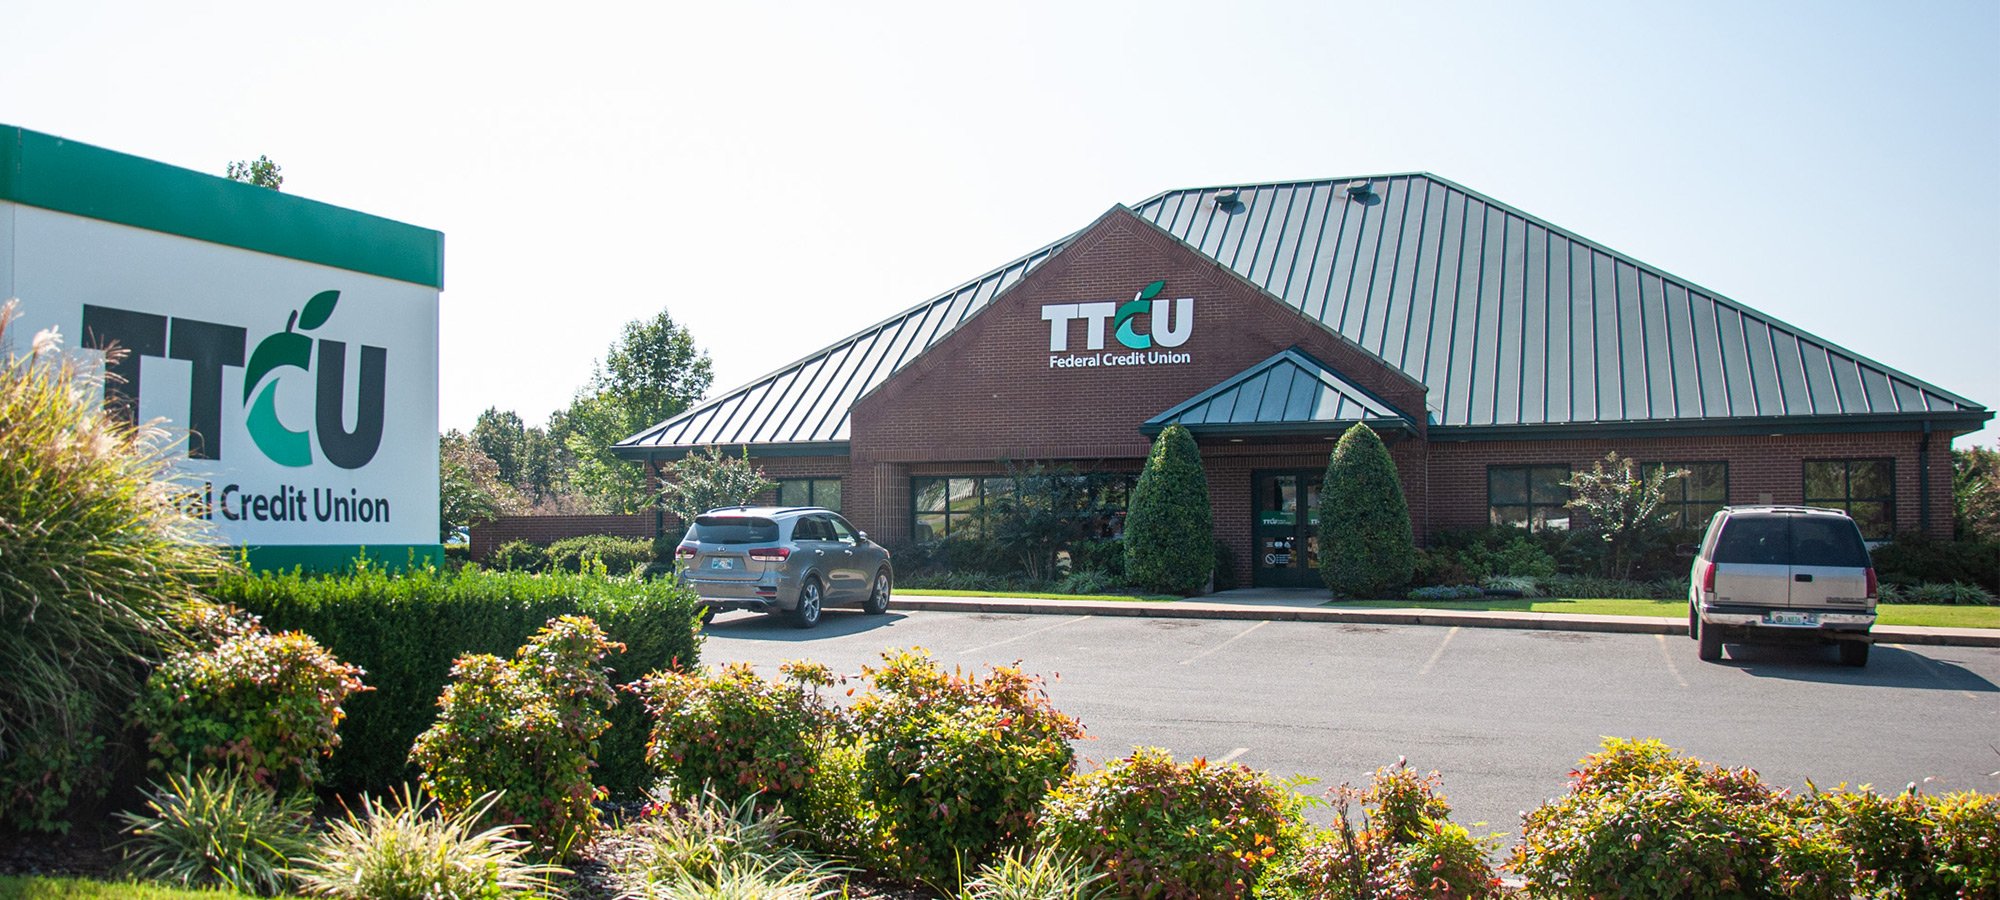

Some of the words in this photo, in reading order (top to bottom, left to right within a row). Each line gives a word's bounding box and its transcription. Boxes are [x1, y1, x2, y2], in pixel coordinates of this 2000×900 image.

[1041, 298, 1194, 351] TTCU
[1049, 353, 1100, 368] Federal
[1102, 351, 1146, 366] Credit
[1147, 350, 1191, 364] Union
[82, 303, 388, 470] TTCU
[220, 484, 308, 521] Credit
[313, 487, 390, 522] Union
